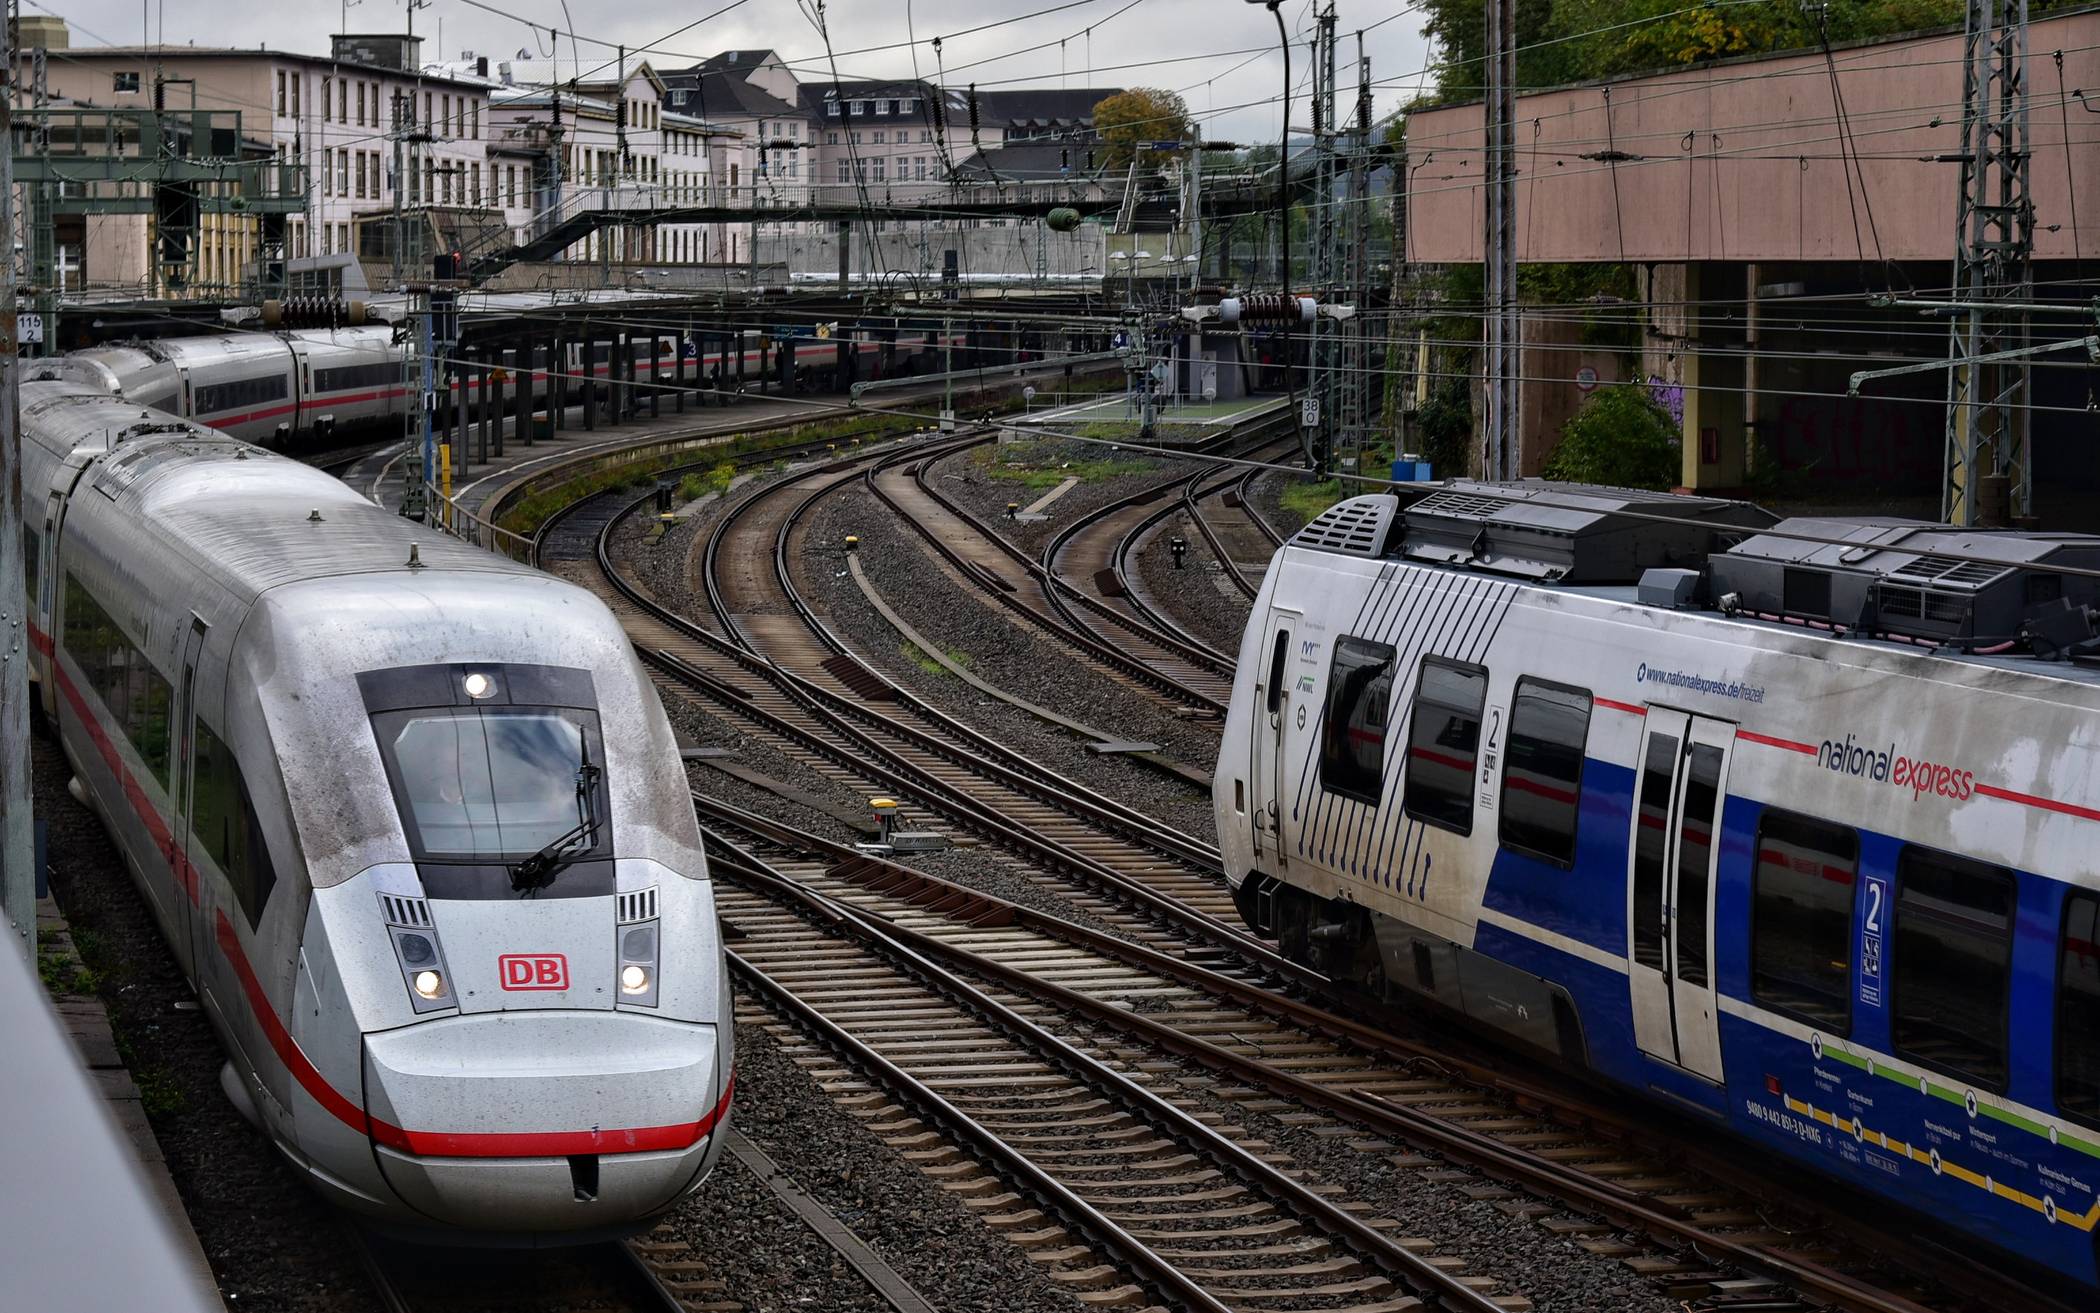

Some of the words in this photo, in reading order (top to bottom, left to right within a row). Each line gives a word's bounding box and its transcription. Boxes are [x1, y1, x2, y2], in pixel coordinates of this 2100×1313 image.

[18, 316, 41, 328] 115
[26, 330, 34, 341] 2
[688, 343, 697, 356] 3
[1303, 400, 1318, 411] 38
[1306, 412, 1315, 424] 0
[1646, 667, 1765, 704] www.nationalexpress.de/freizeit
[1487, 710, 1501, 749] 2
[1817, 733, 1896, 783] national
[1893, 755, 1974, 802] express
[1866, 882, 1881, 932] 2
[508, 959, 561, 985] DB
